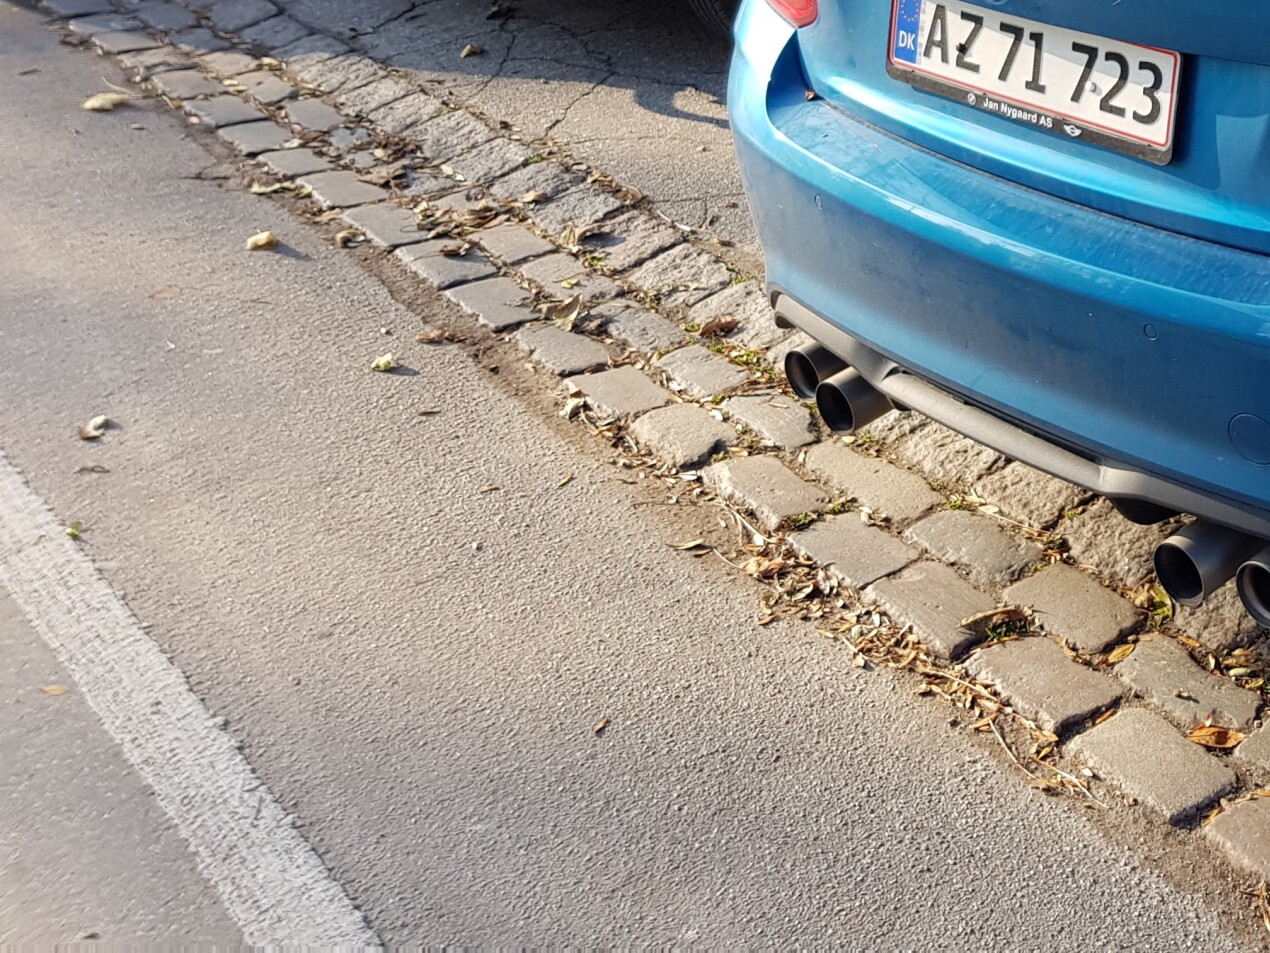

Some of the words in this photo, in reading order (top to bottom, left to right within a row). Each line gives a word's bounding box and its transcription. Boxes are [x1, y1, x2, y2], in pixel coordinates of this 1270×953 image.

[898, 29, 916, 51] DK
[922, 3, 984, 74] AZ
[997, 21, 1047, 94] 71
[1069, 41, 1164, 125] 723
[983, 96, 999, 111] Jan
[1000, 101, 1038, 124] Nygaard
[1039, 115, 1053, 128] AS
